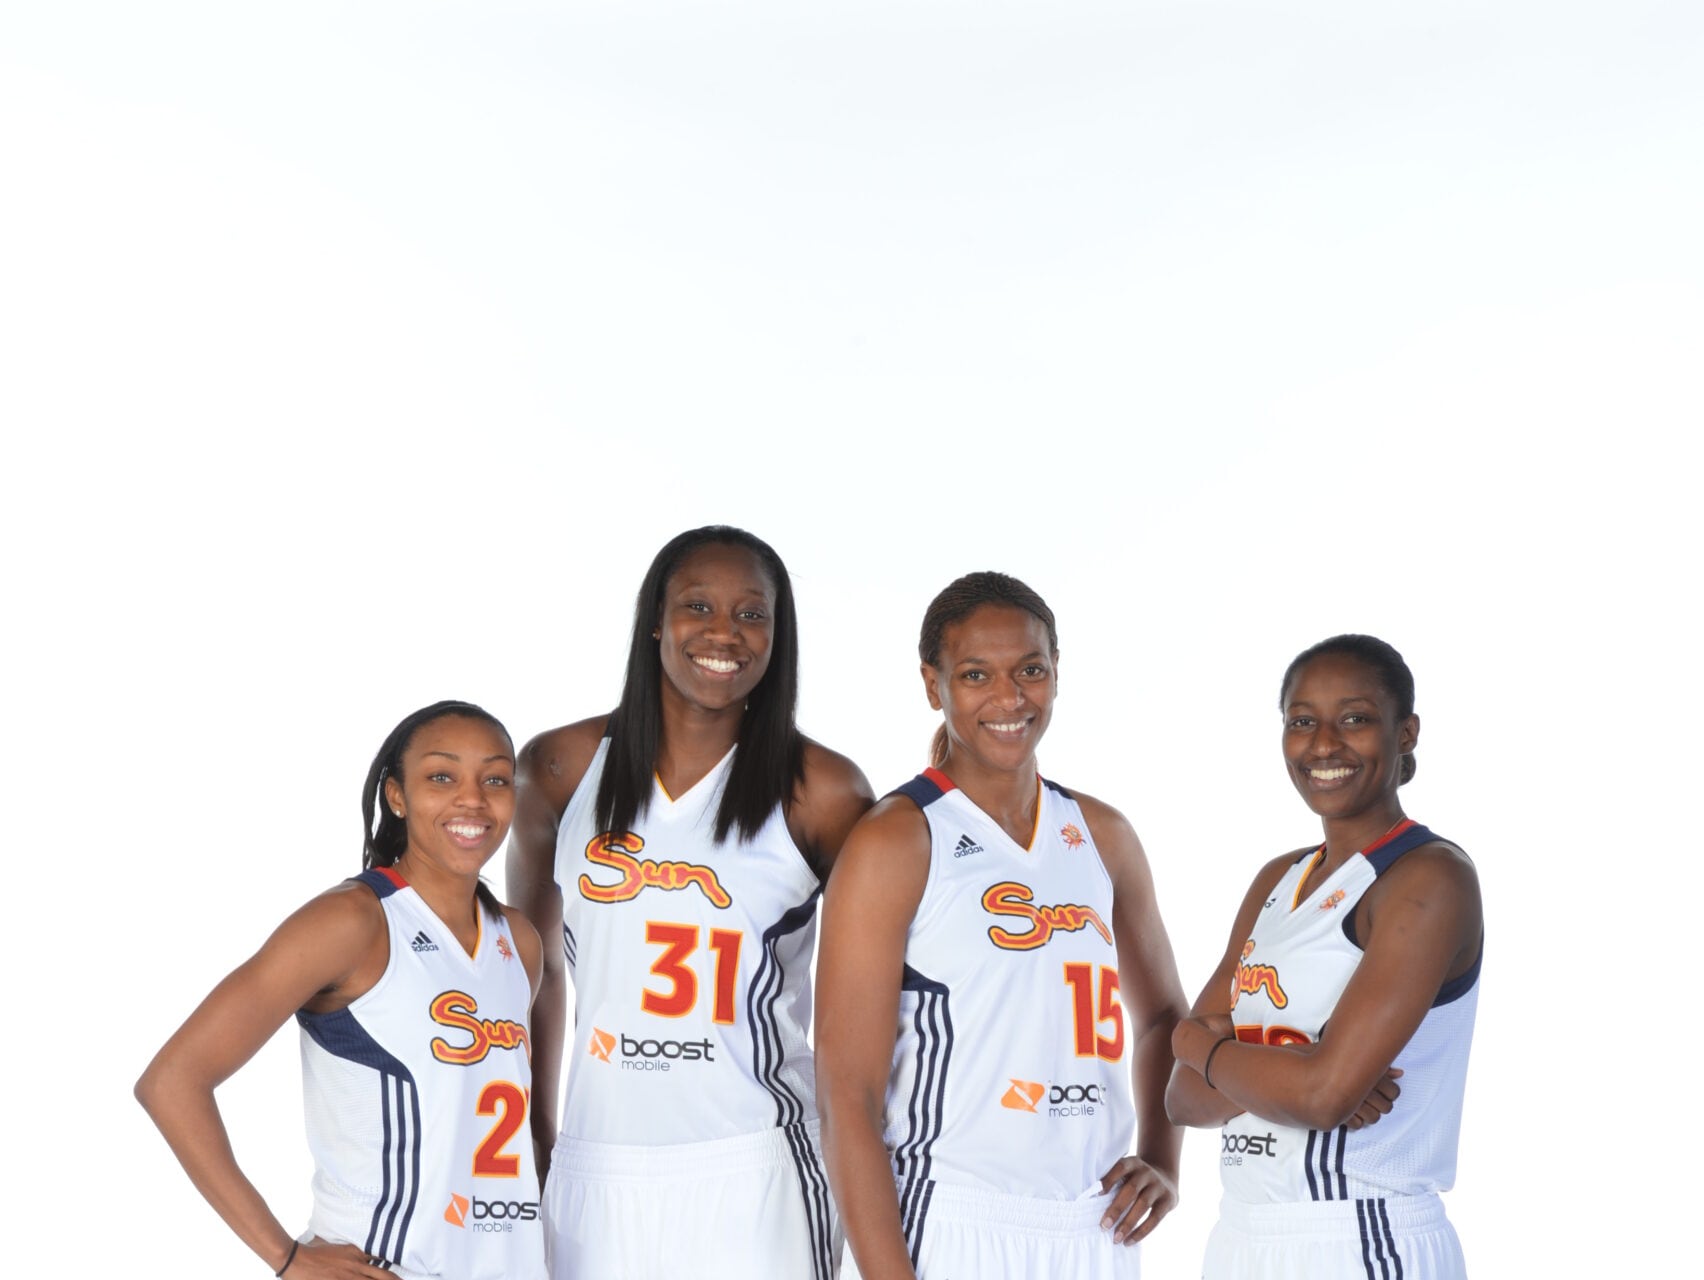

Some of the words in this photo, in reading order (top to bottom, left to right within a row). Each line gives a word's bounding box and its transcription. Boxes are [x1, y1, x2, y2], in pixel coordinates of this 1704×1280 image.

[578, 830, 733, 910] Sun
[953, 844, 985, 858] adidas
[981, 881, 1113, 951] Sun
[641, 920, 744, 1026] 31
[429, 989, 532, 1066] Sun
[1063, 962, 1125, 1064] 15
[621, 1033, 715, 1062] boost
[621, 1060, 671, 1072] mobile
[472, 1079, 529, 1178] 2
[1048, 1105, 1095, 1118] mobile
[472, 1195, 542, 1221] boos
[473, 1221, 513, 1233] mobile
